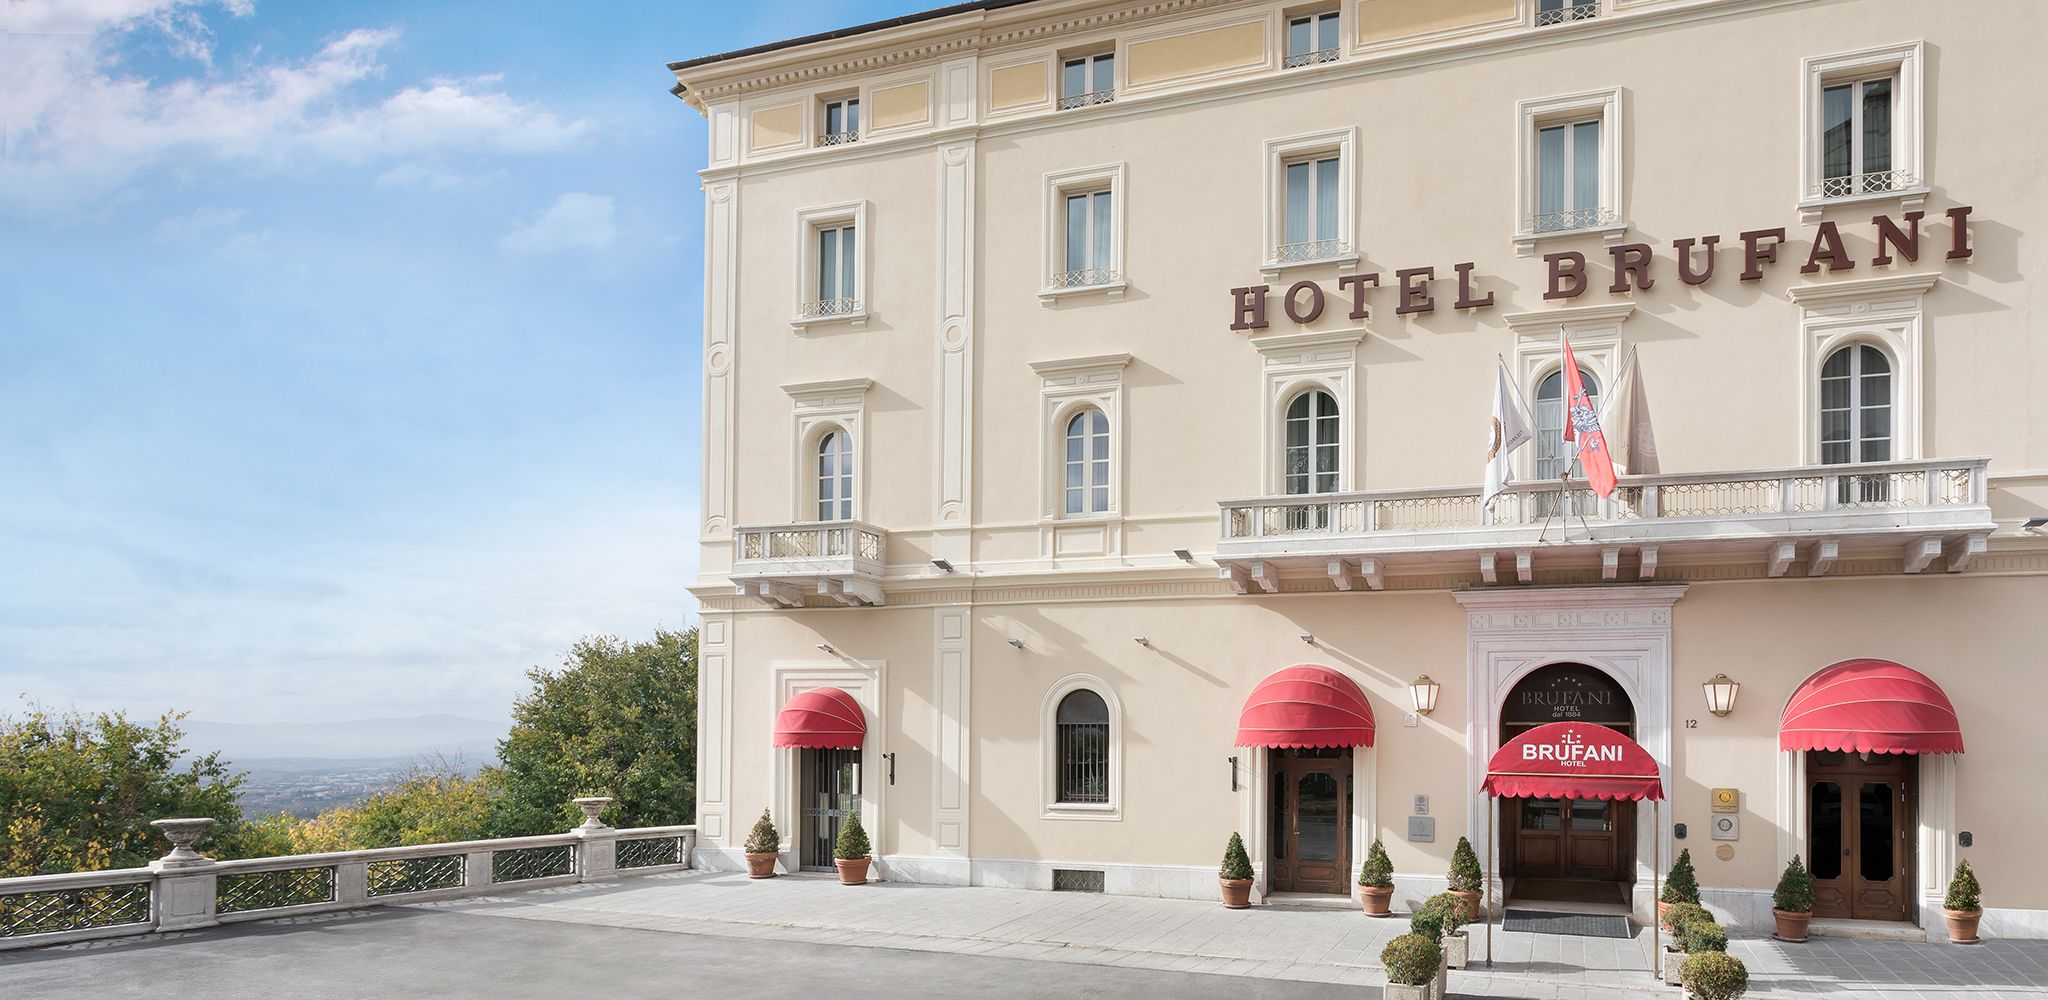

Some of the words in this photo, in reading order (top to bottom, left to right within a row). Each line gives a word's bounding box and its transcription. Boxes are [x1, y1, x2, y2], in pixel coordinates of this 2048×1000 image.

[1230, 262, 1494, 332] HOTEL
[1543, 205, 1975, 302] BRUFANI
[1521, 691, 1614, 705] BRUFANI
[1685, 720, 1697, 728] 12
[1522, 744, 1623, 761] BRUFANI
